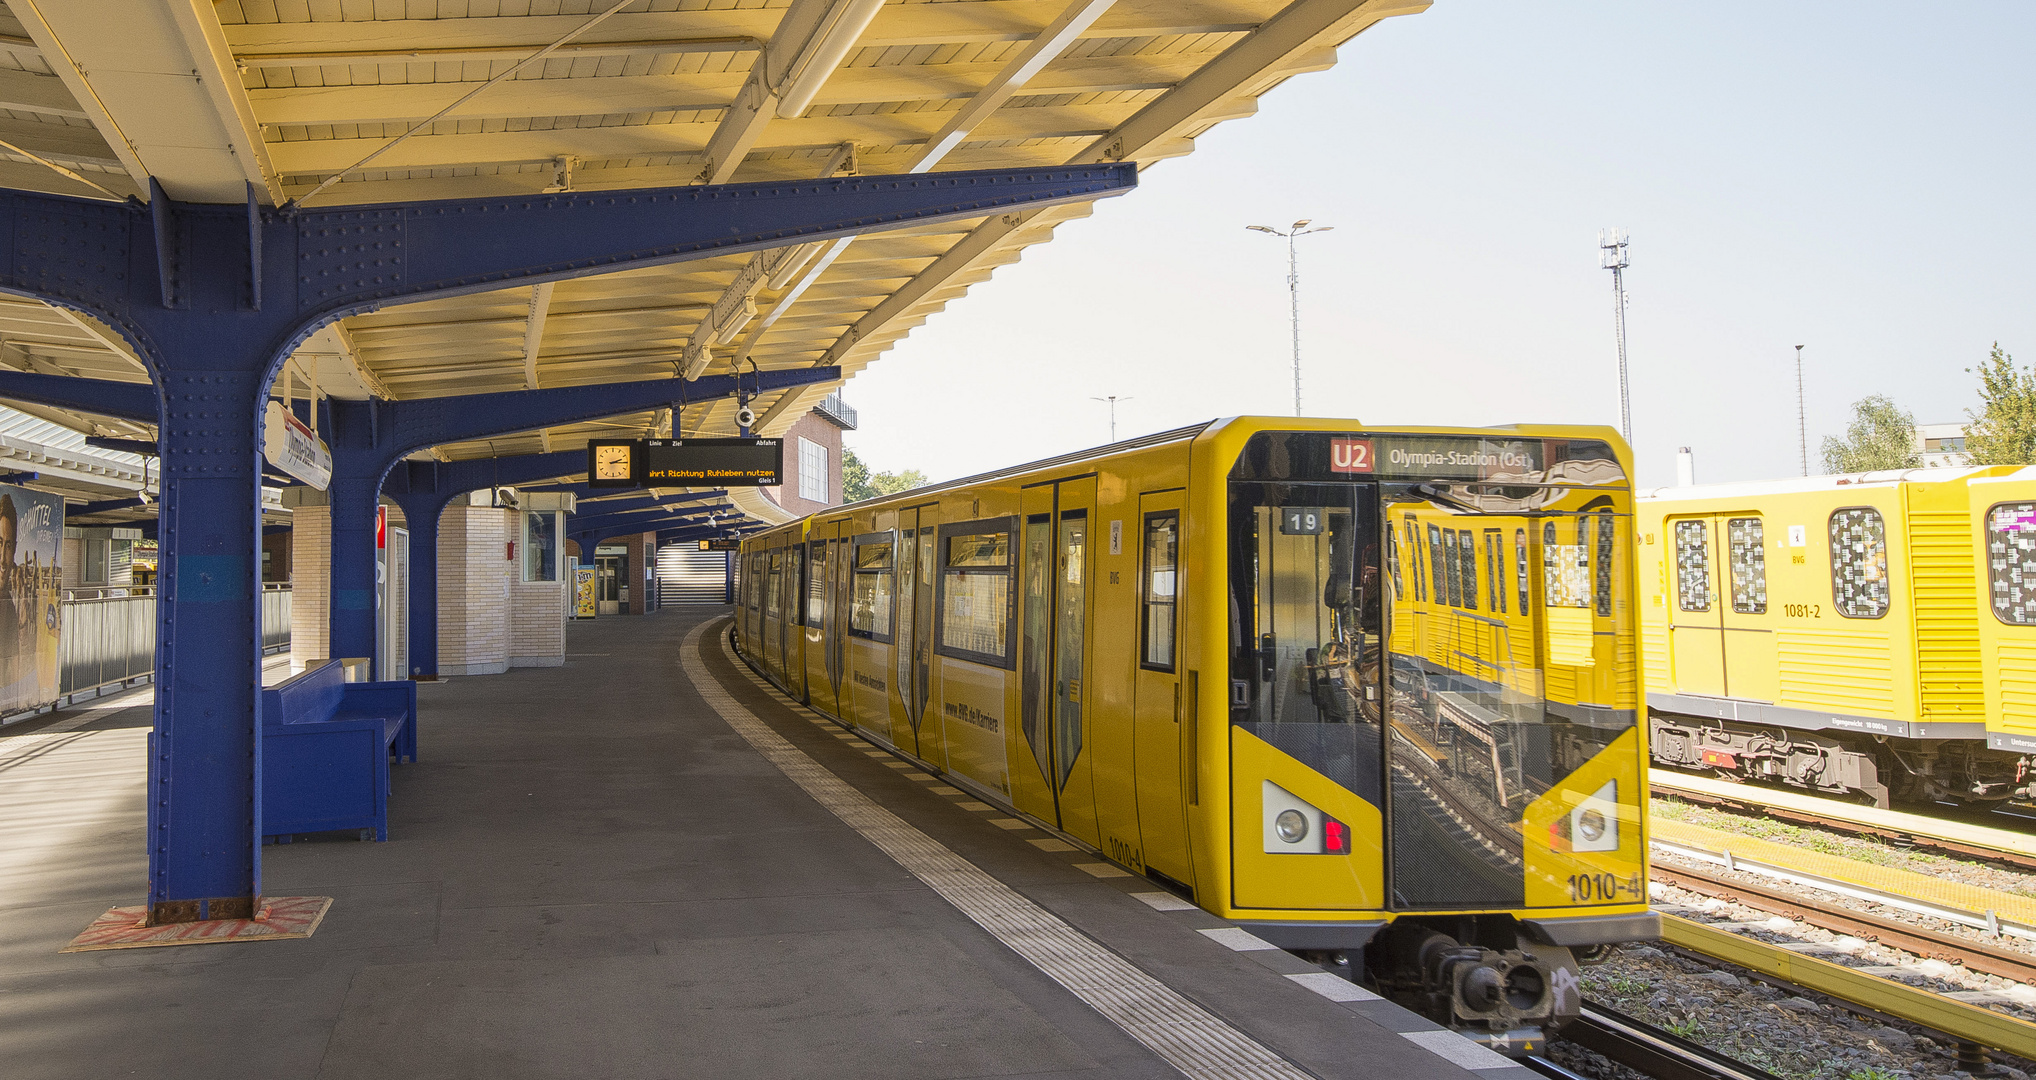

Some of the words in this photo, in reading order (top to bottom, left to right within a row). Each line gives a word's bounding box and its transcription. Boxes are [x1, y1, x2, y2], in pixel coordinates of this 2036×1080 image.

[1334, 444, 1367, 467] U2
[1389, 448, 1497, 468] Olympia-Stadion
[1499, 451, 1531, 469] (Ost)
[668, 470, 704, 478] Richtung
[707, 469, 743, 477] Ruhleben
[747, 469, 774, 477] nutzen
[1792, 555, 1805, 564] BVG
[1784, 604, 1820, 618] 1081-2
[1832, 717, 1863, 728] Eigengewicht
[1109, 836, 1143, 872] 1010-4
[1567, 872, 1640, 901] 1010-4
